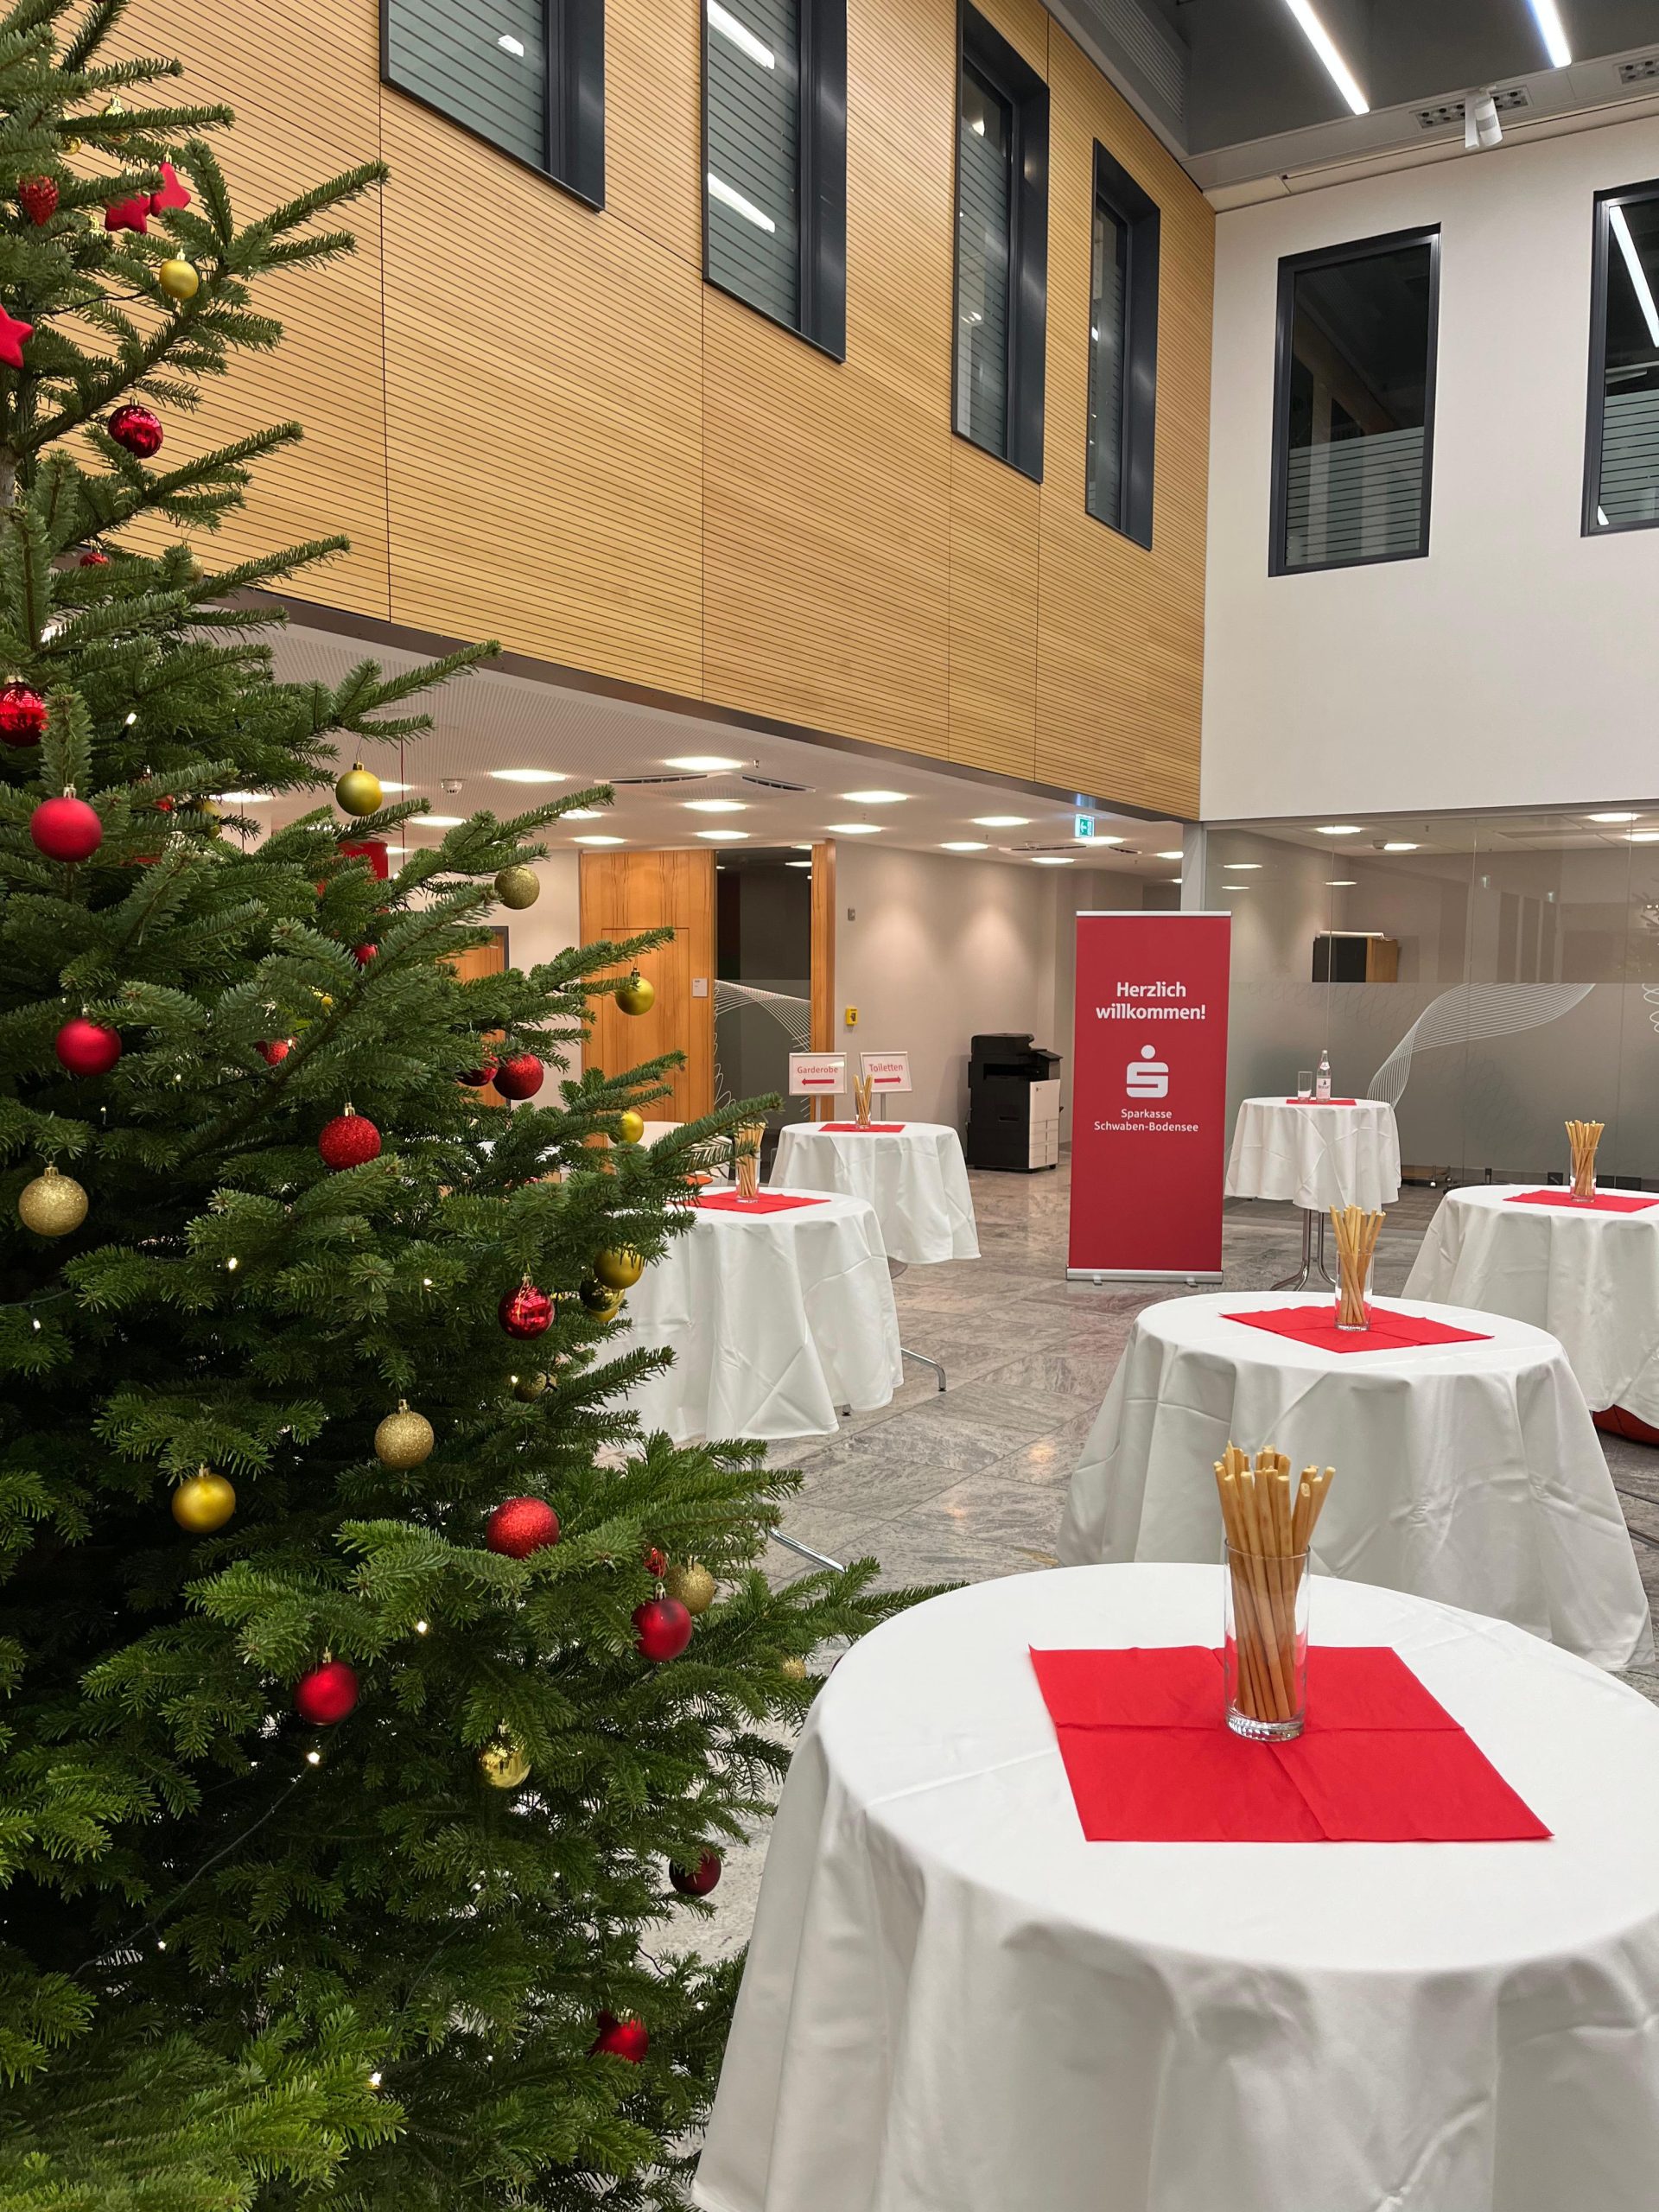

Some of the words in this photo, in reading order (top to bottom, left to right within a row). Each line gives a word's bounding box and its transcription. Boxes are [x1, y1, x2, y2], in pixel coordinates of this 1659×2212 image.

[1116, 981, 1186, 998] Herzlich
[1096, 1003, 1206, 1020] willkommen!
[797, 1065, 839, 1074] Garderobe
[868, 1064, 904, 1072] Toiletten
[1121, 1109, 1173, 1120] Sparkasse
[1094, 1121, 1199, 1132] Schwaben-Bodensee
